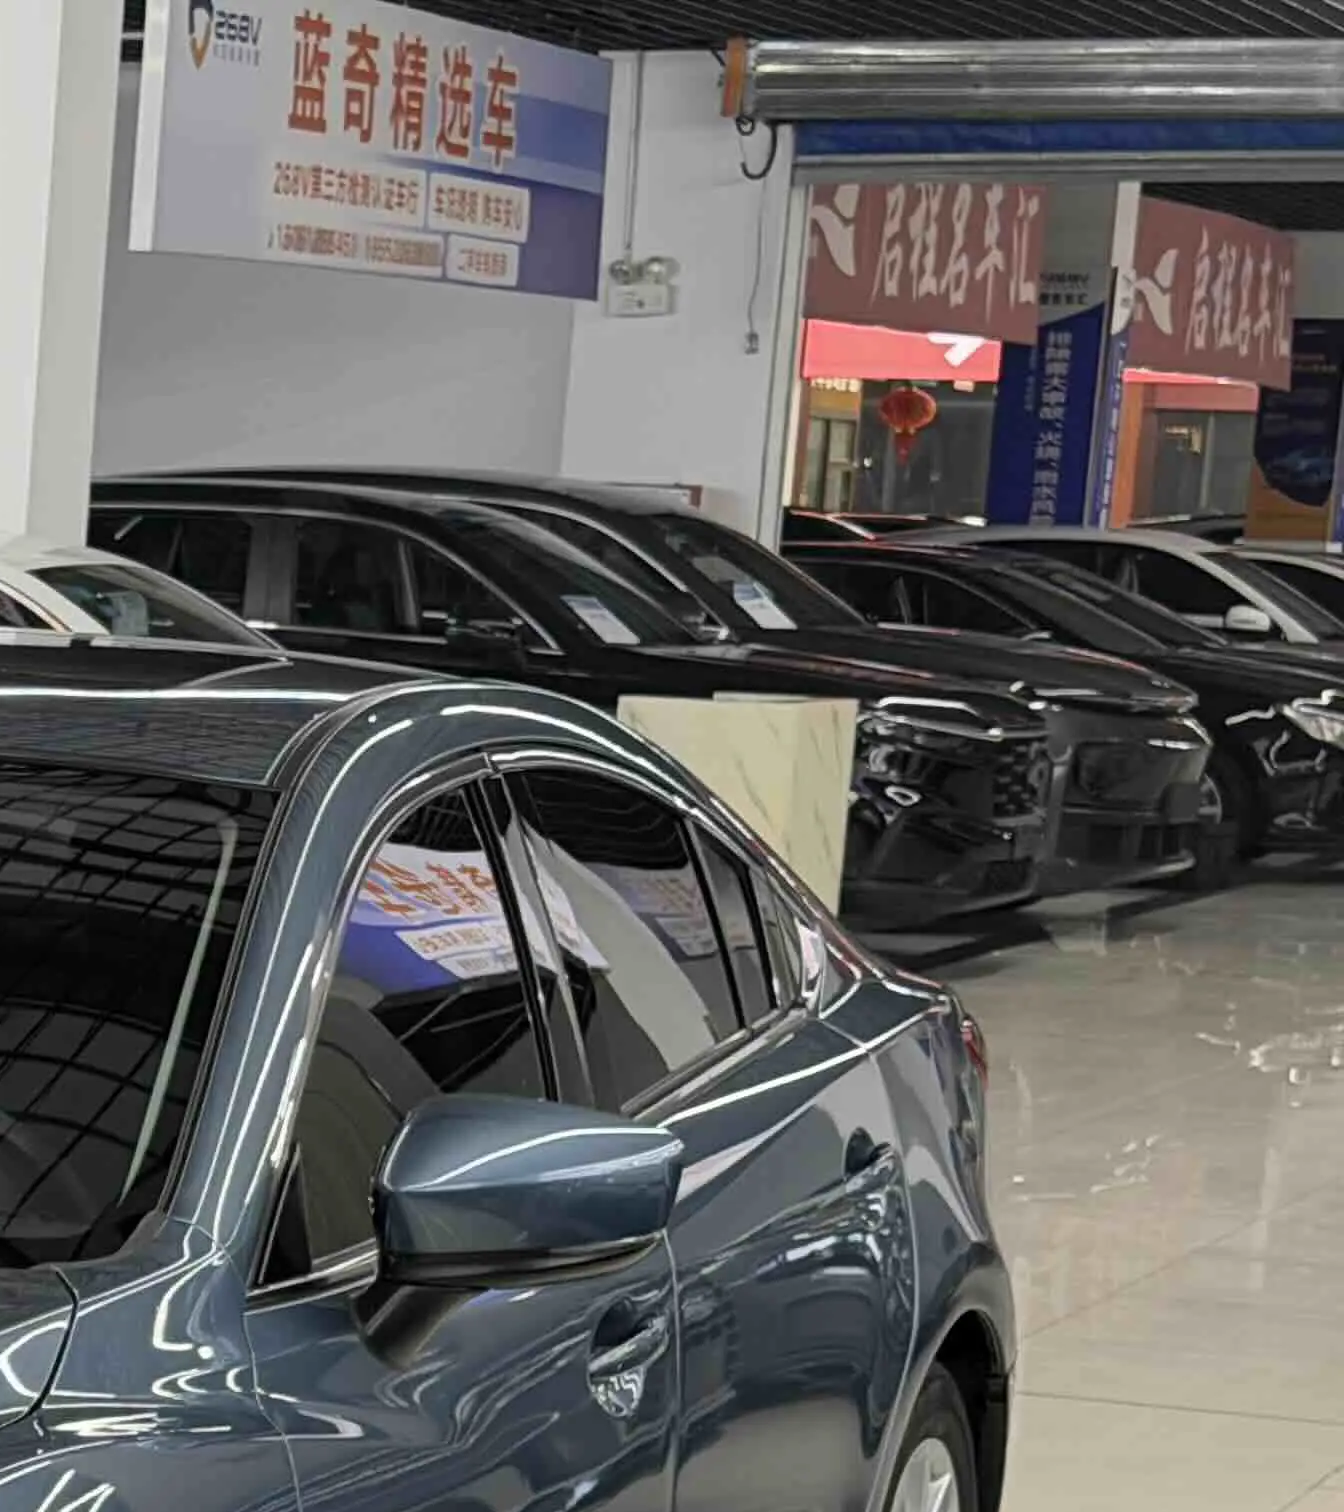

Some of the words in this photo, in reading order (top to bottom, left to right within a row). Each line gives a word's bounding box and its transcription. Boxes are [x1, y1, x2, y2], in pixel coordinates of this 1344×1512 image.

[216, 10, 262, 46] 268V
[287, 8, 520, 169] 蓝奇精选车
